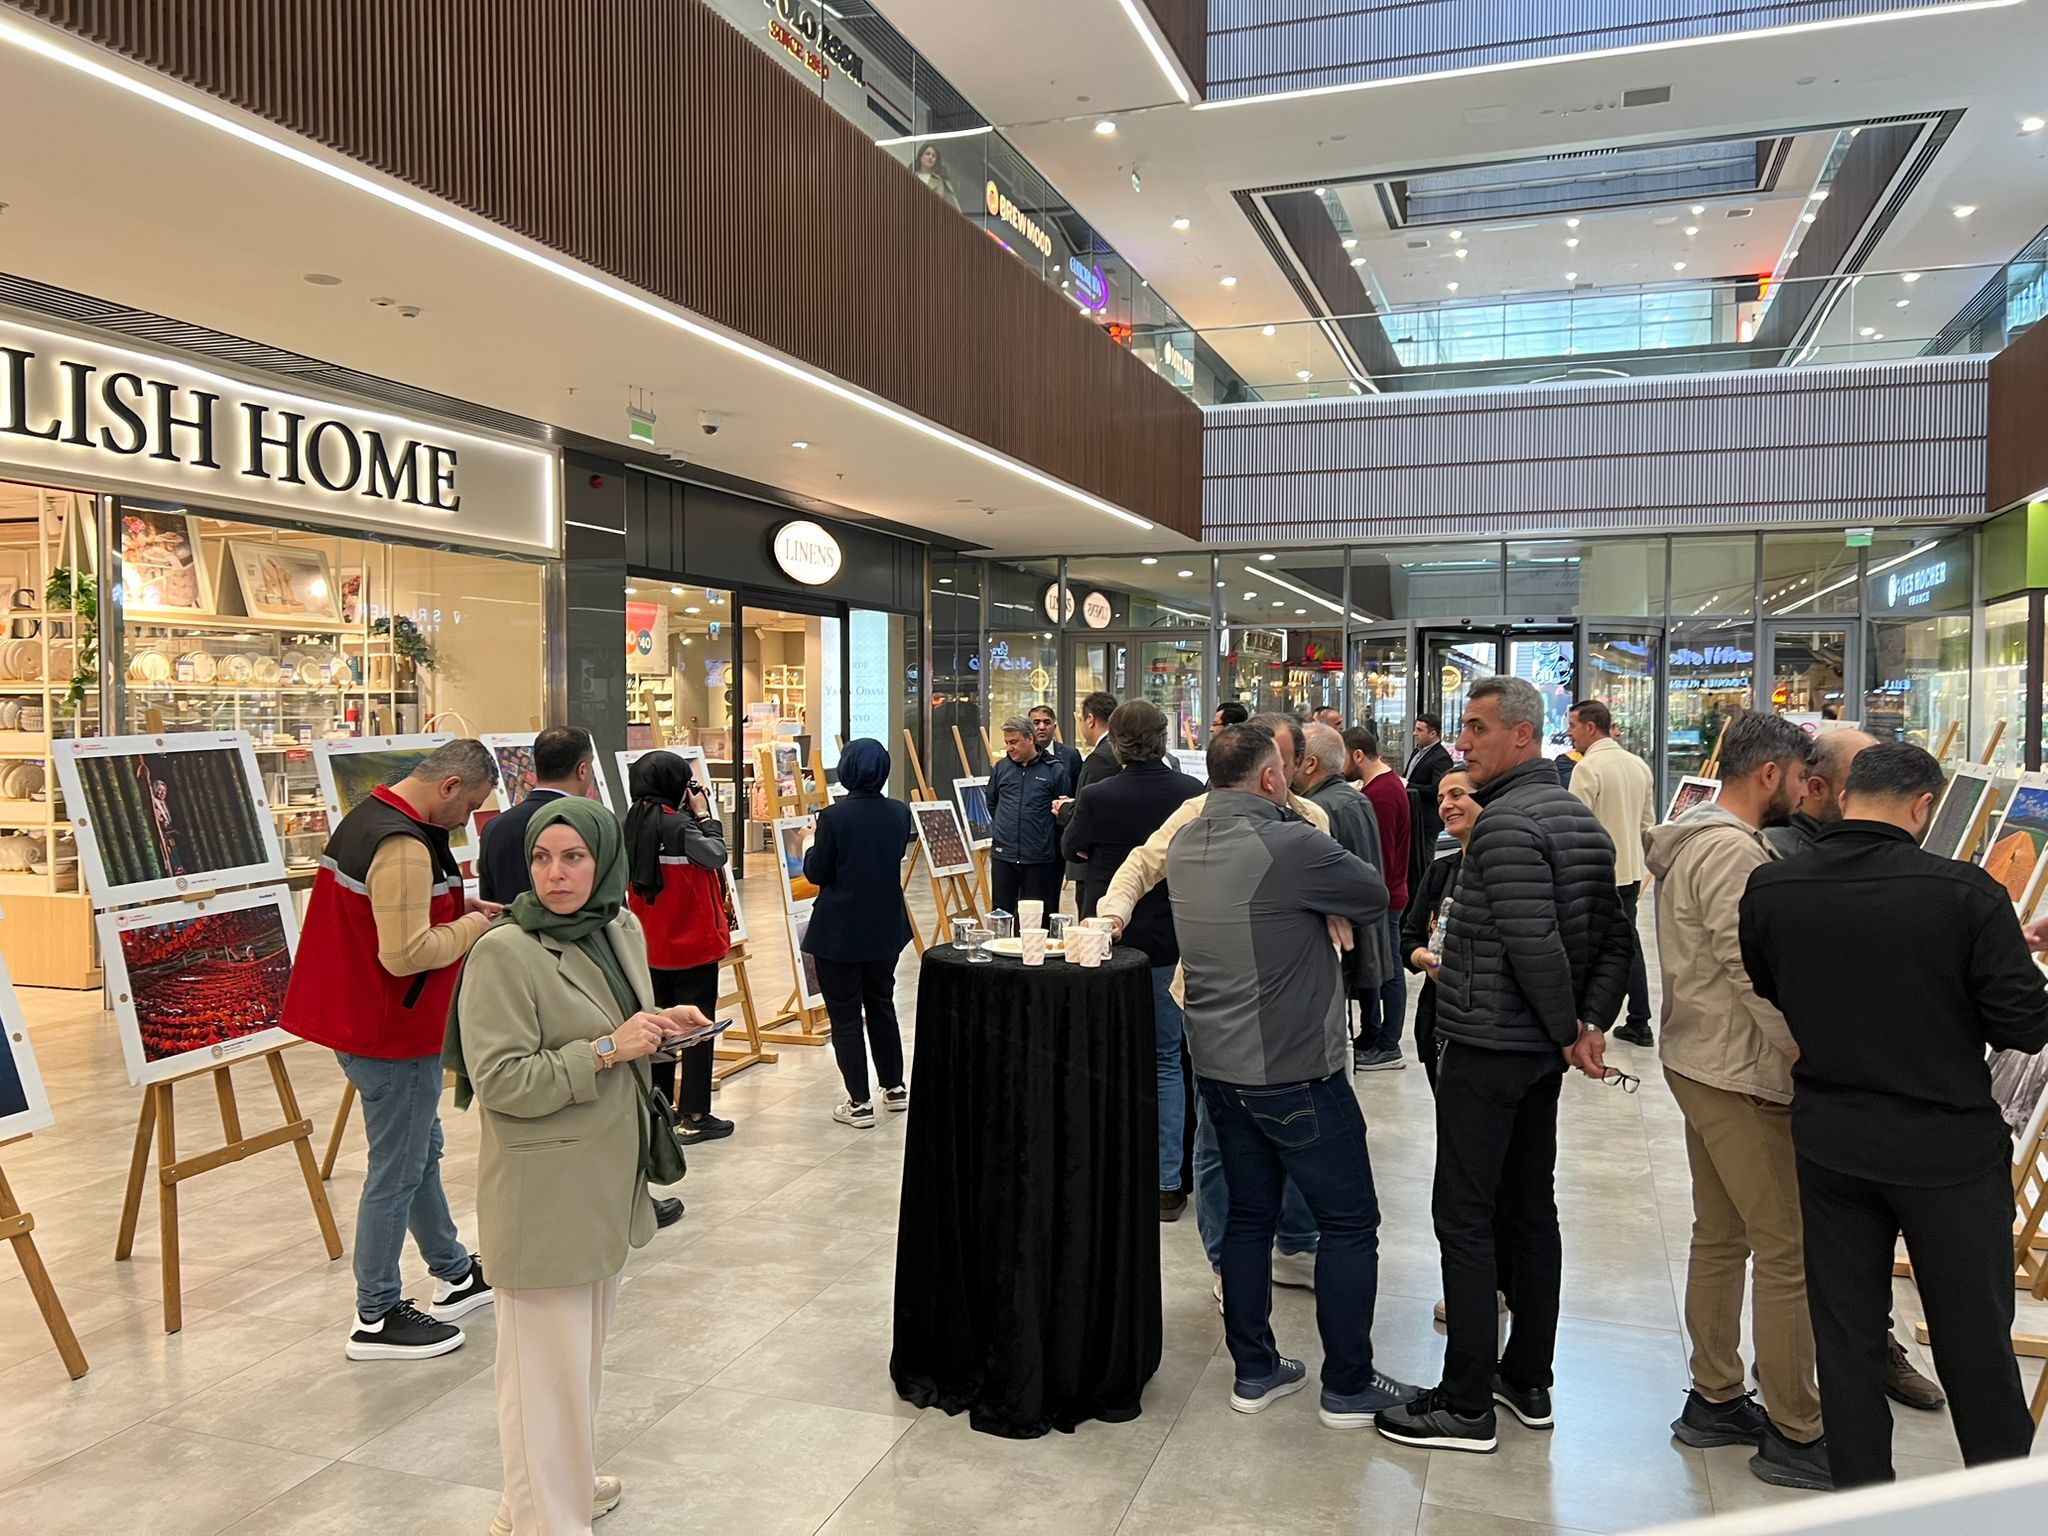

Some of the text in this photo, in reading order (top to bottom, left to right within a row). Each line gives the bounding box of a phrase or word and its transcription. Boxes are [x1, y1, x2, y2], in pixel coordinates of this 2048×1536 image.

[763, 0, 816, 43] OLO
[241, 402, 461, 512] HOME
[785, 538, 834, 568] LINENS
[1914, 561, 1947, 592] ROCHER
